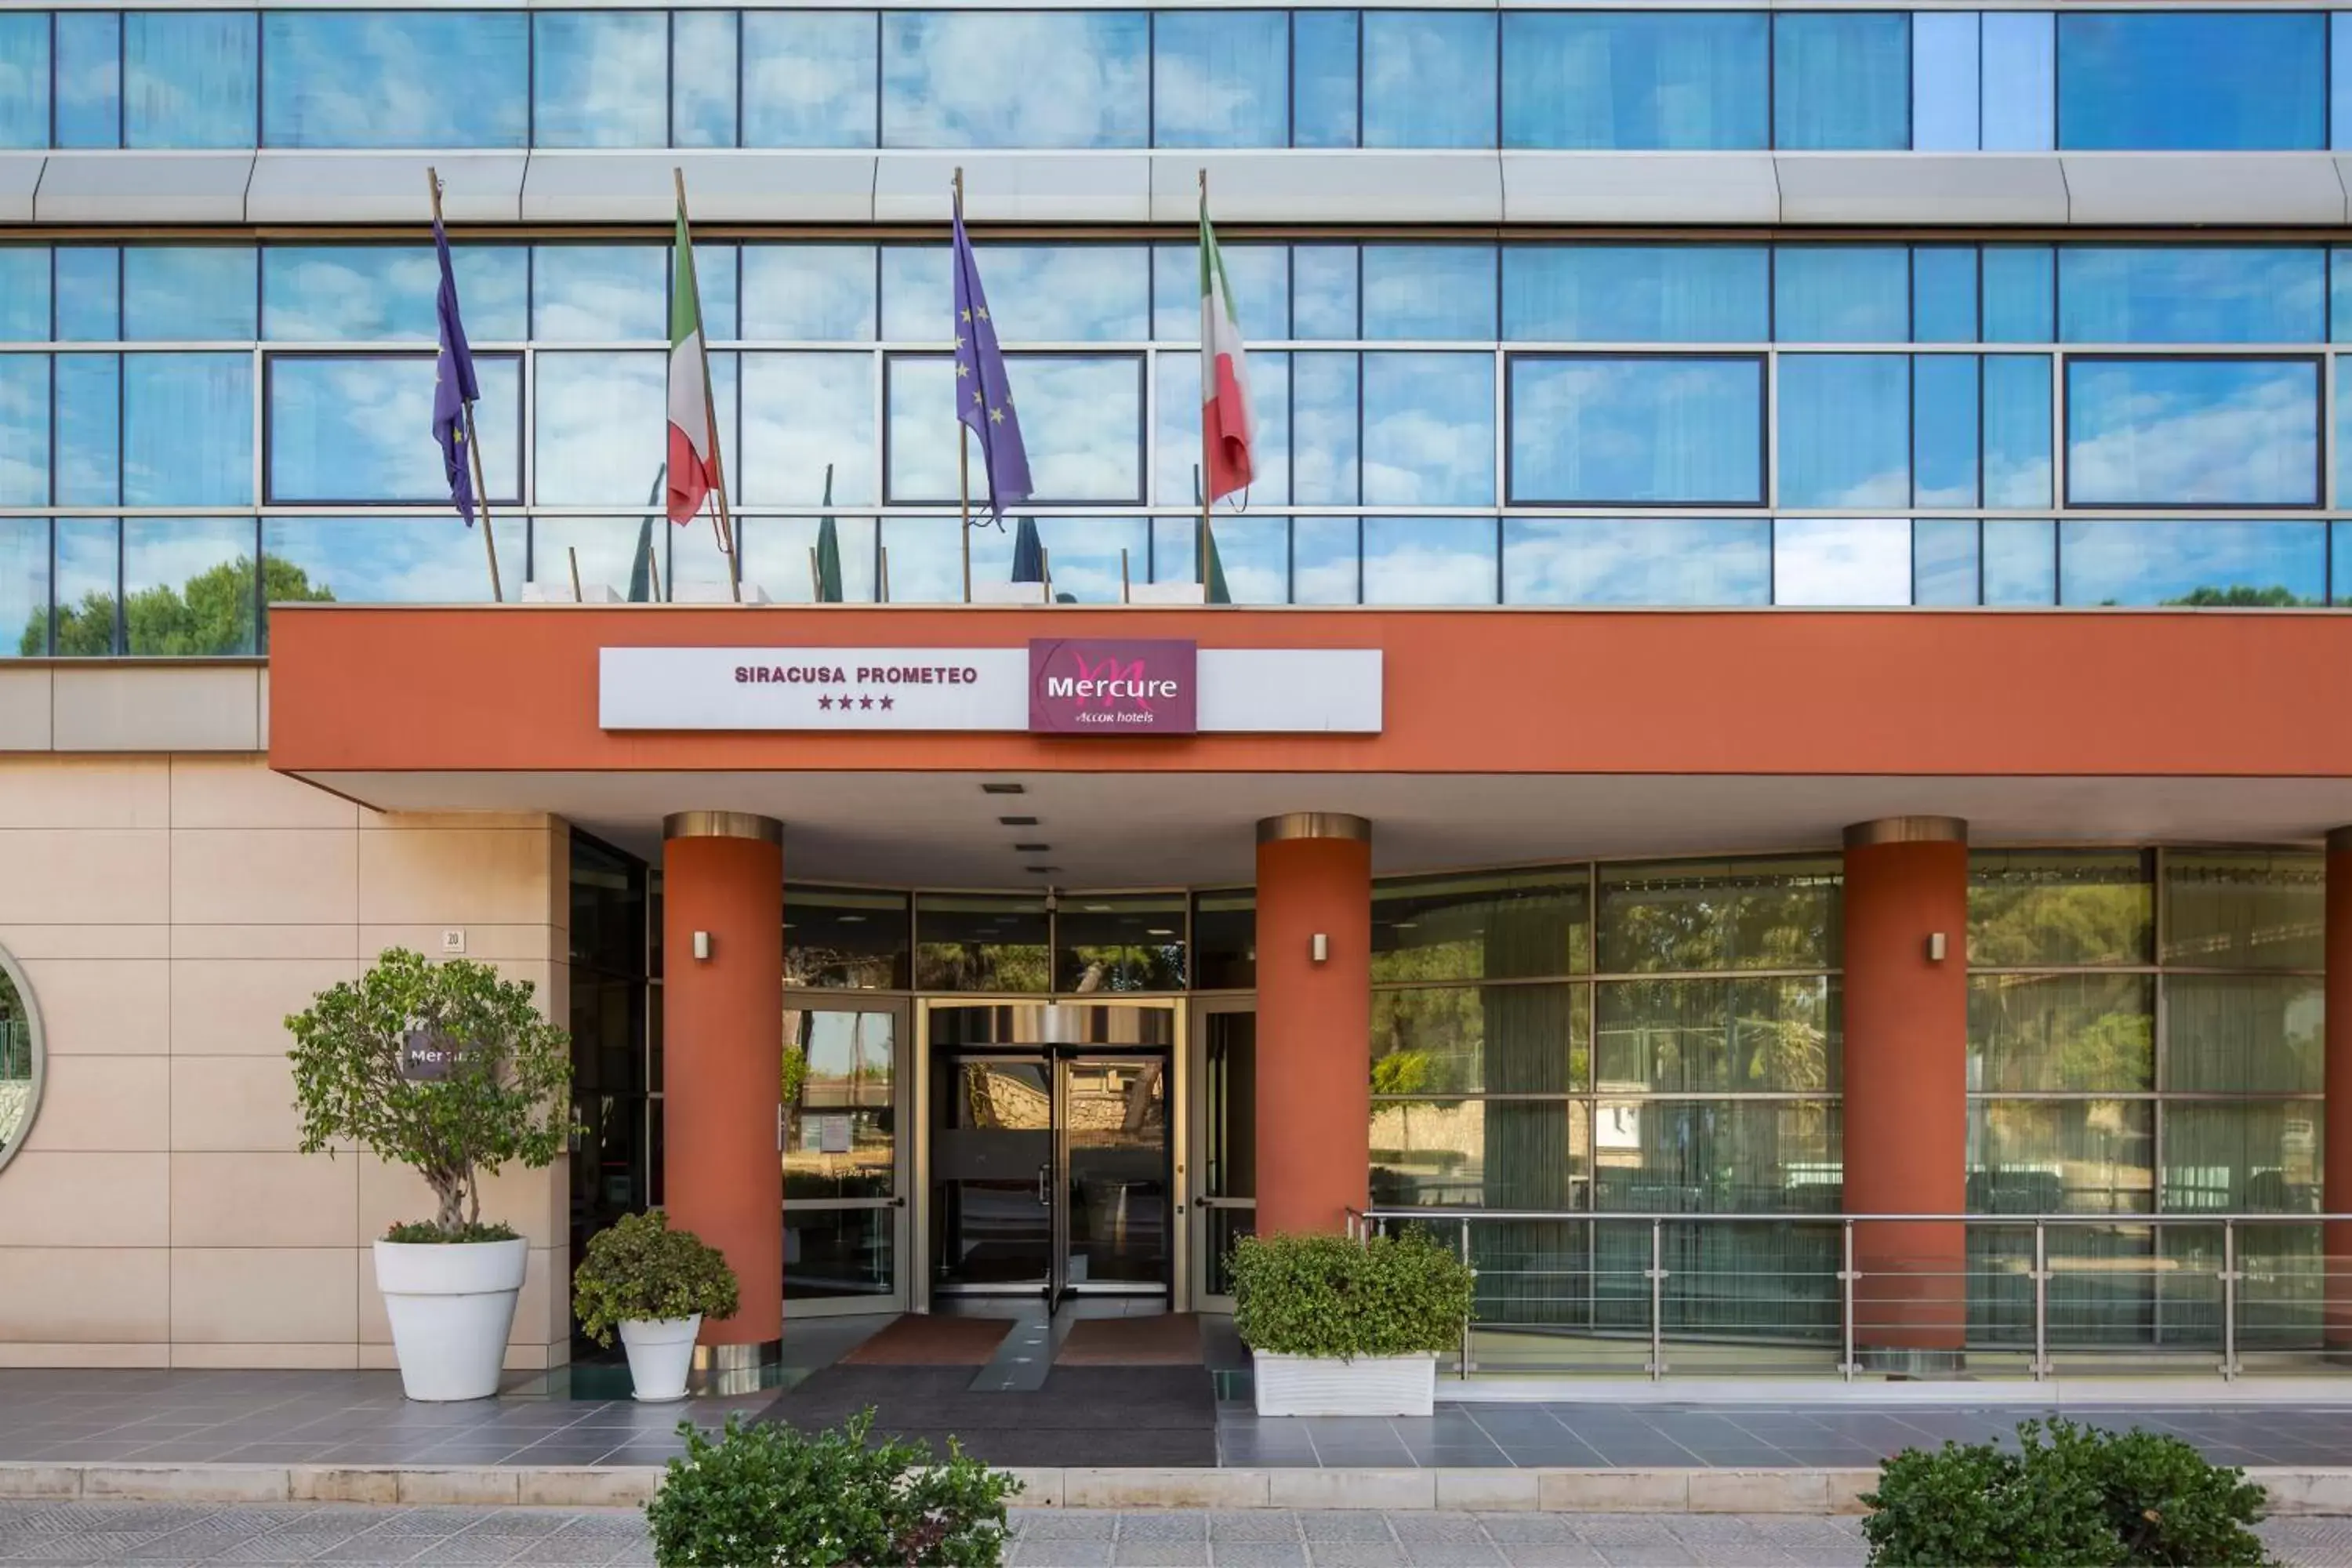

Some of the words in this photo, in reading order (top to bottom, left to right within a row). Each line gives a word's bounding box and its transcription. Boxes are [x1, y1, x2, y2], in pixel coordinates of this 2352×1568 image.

[735, 666, 847, 684] SIRACUSA
[857, 666, 978, 684] PROMETEO
[1048, 677, 1177, 698] Mercure
[1117, 711, 1154, 723] hotels
[448, 933, 459, 945] 20
